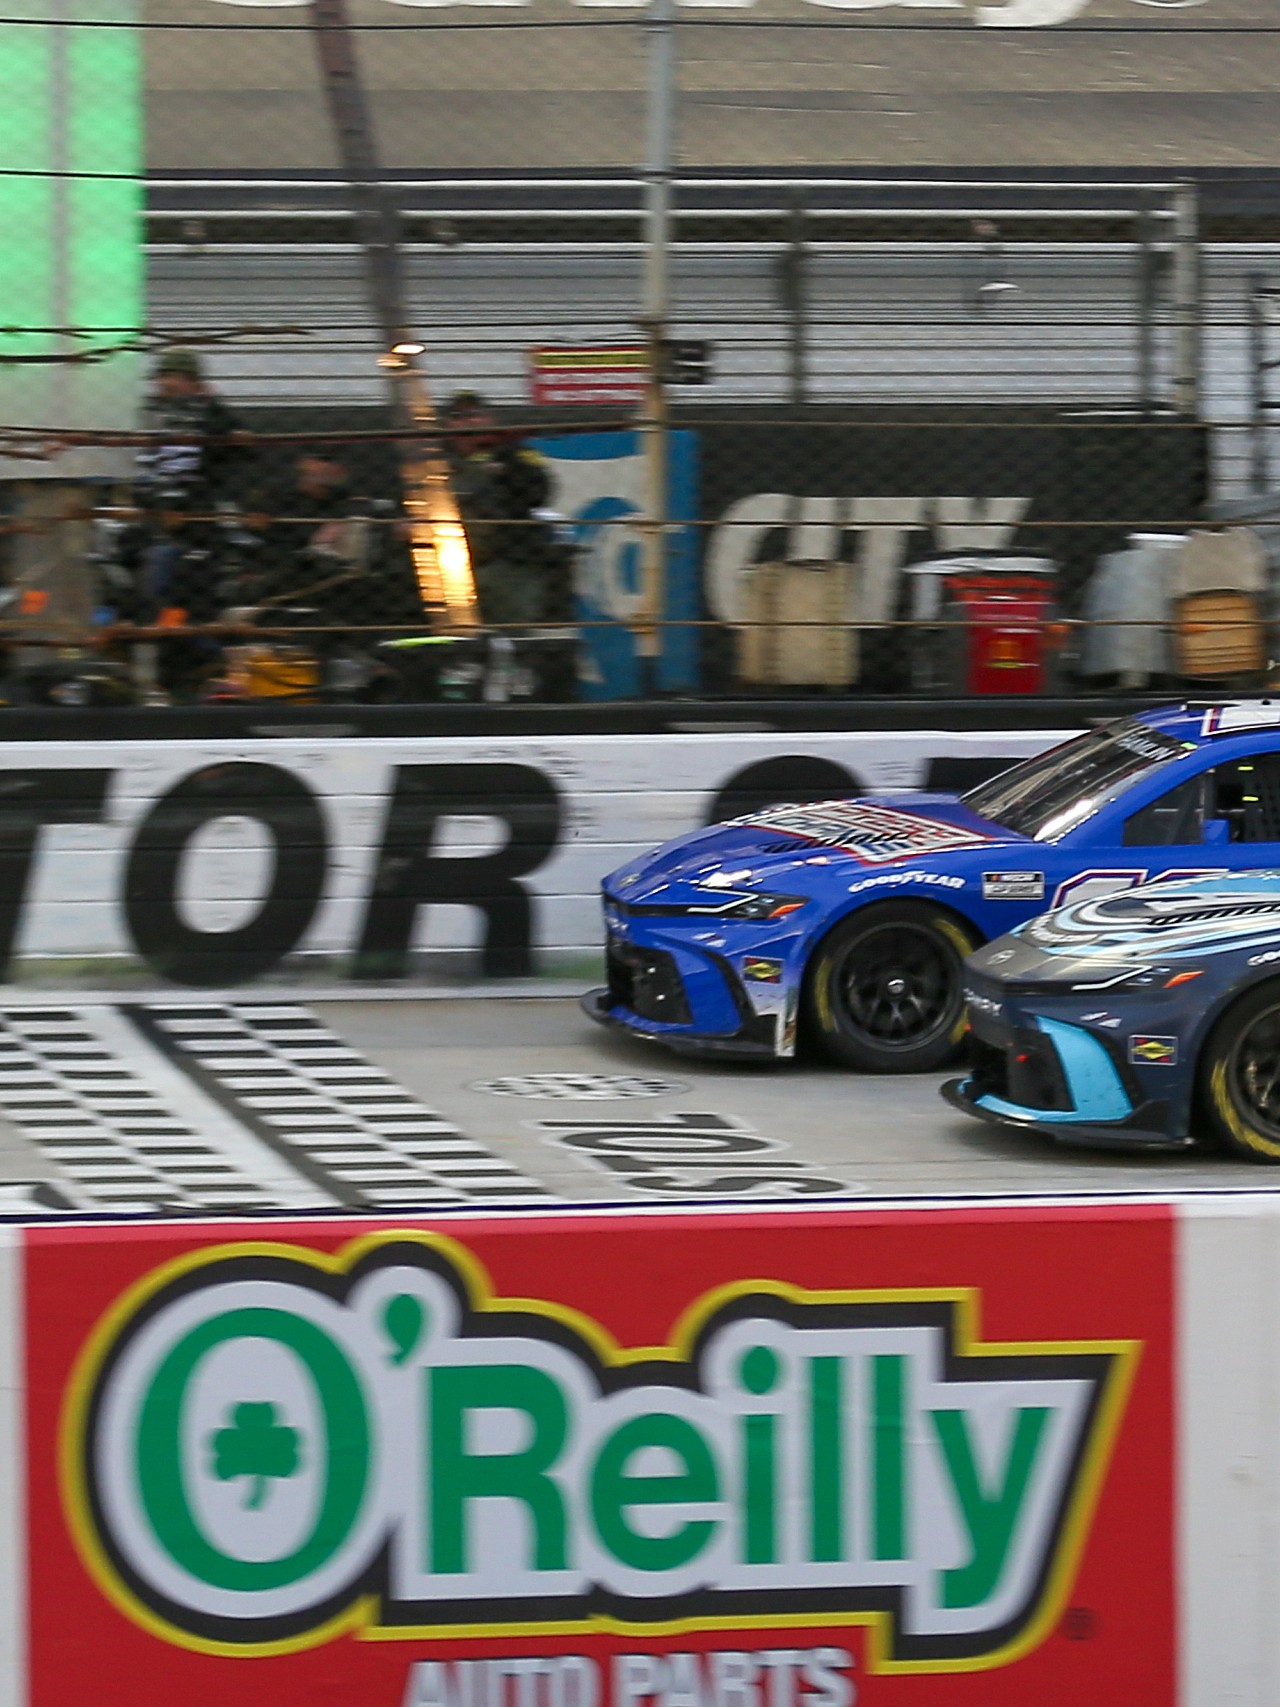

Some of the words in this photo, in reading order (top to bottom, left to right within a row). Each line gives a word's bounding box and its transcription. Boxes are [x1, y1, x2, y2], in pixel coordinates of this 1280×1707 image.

[847, 870, 967, 893] GOODYEAR
[134, 1291, 1050, 1611] O'Reilly
[402, 1654, 600, 1707] AUTO
[610, 1646, 856, 1707] PARTS
